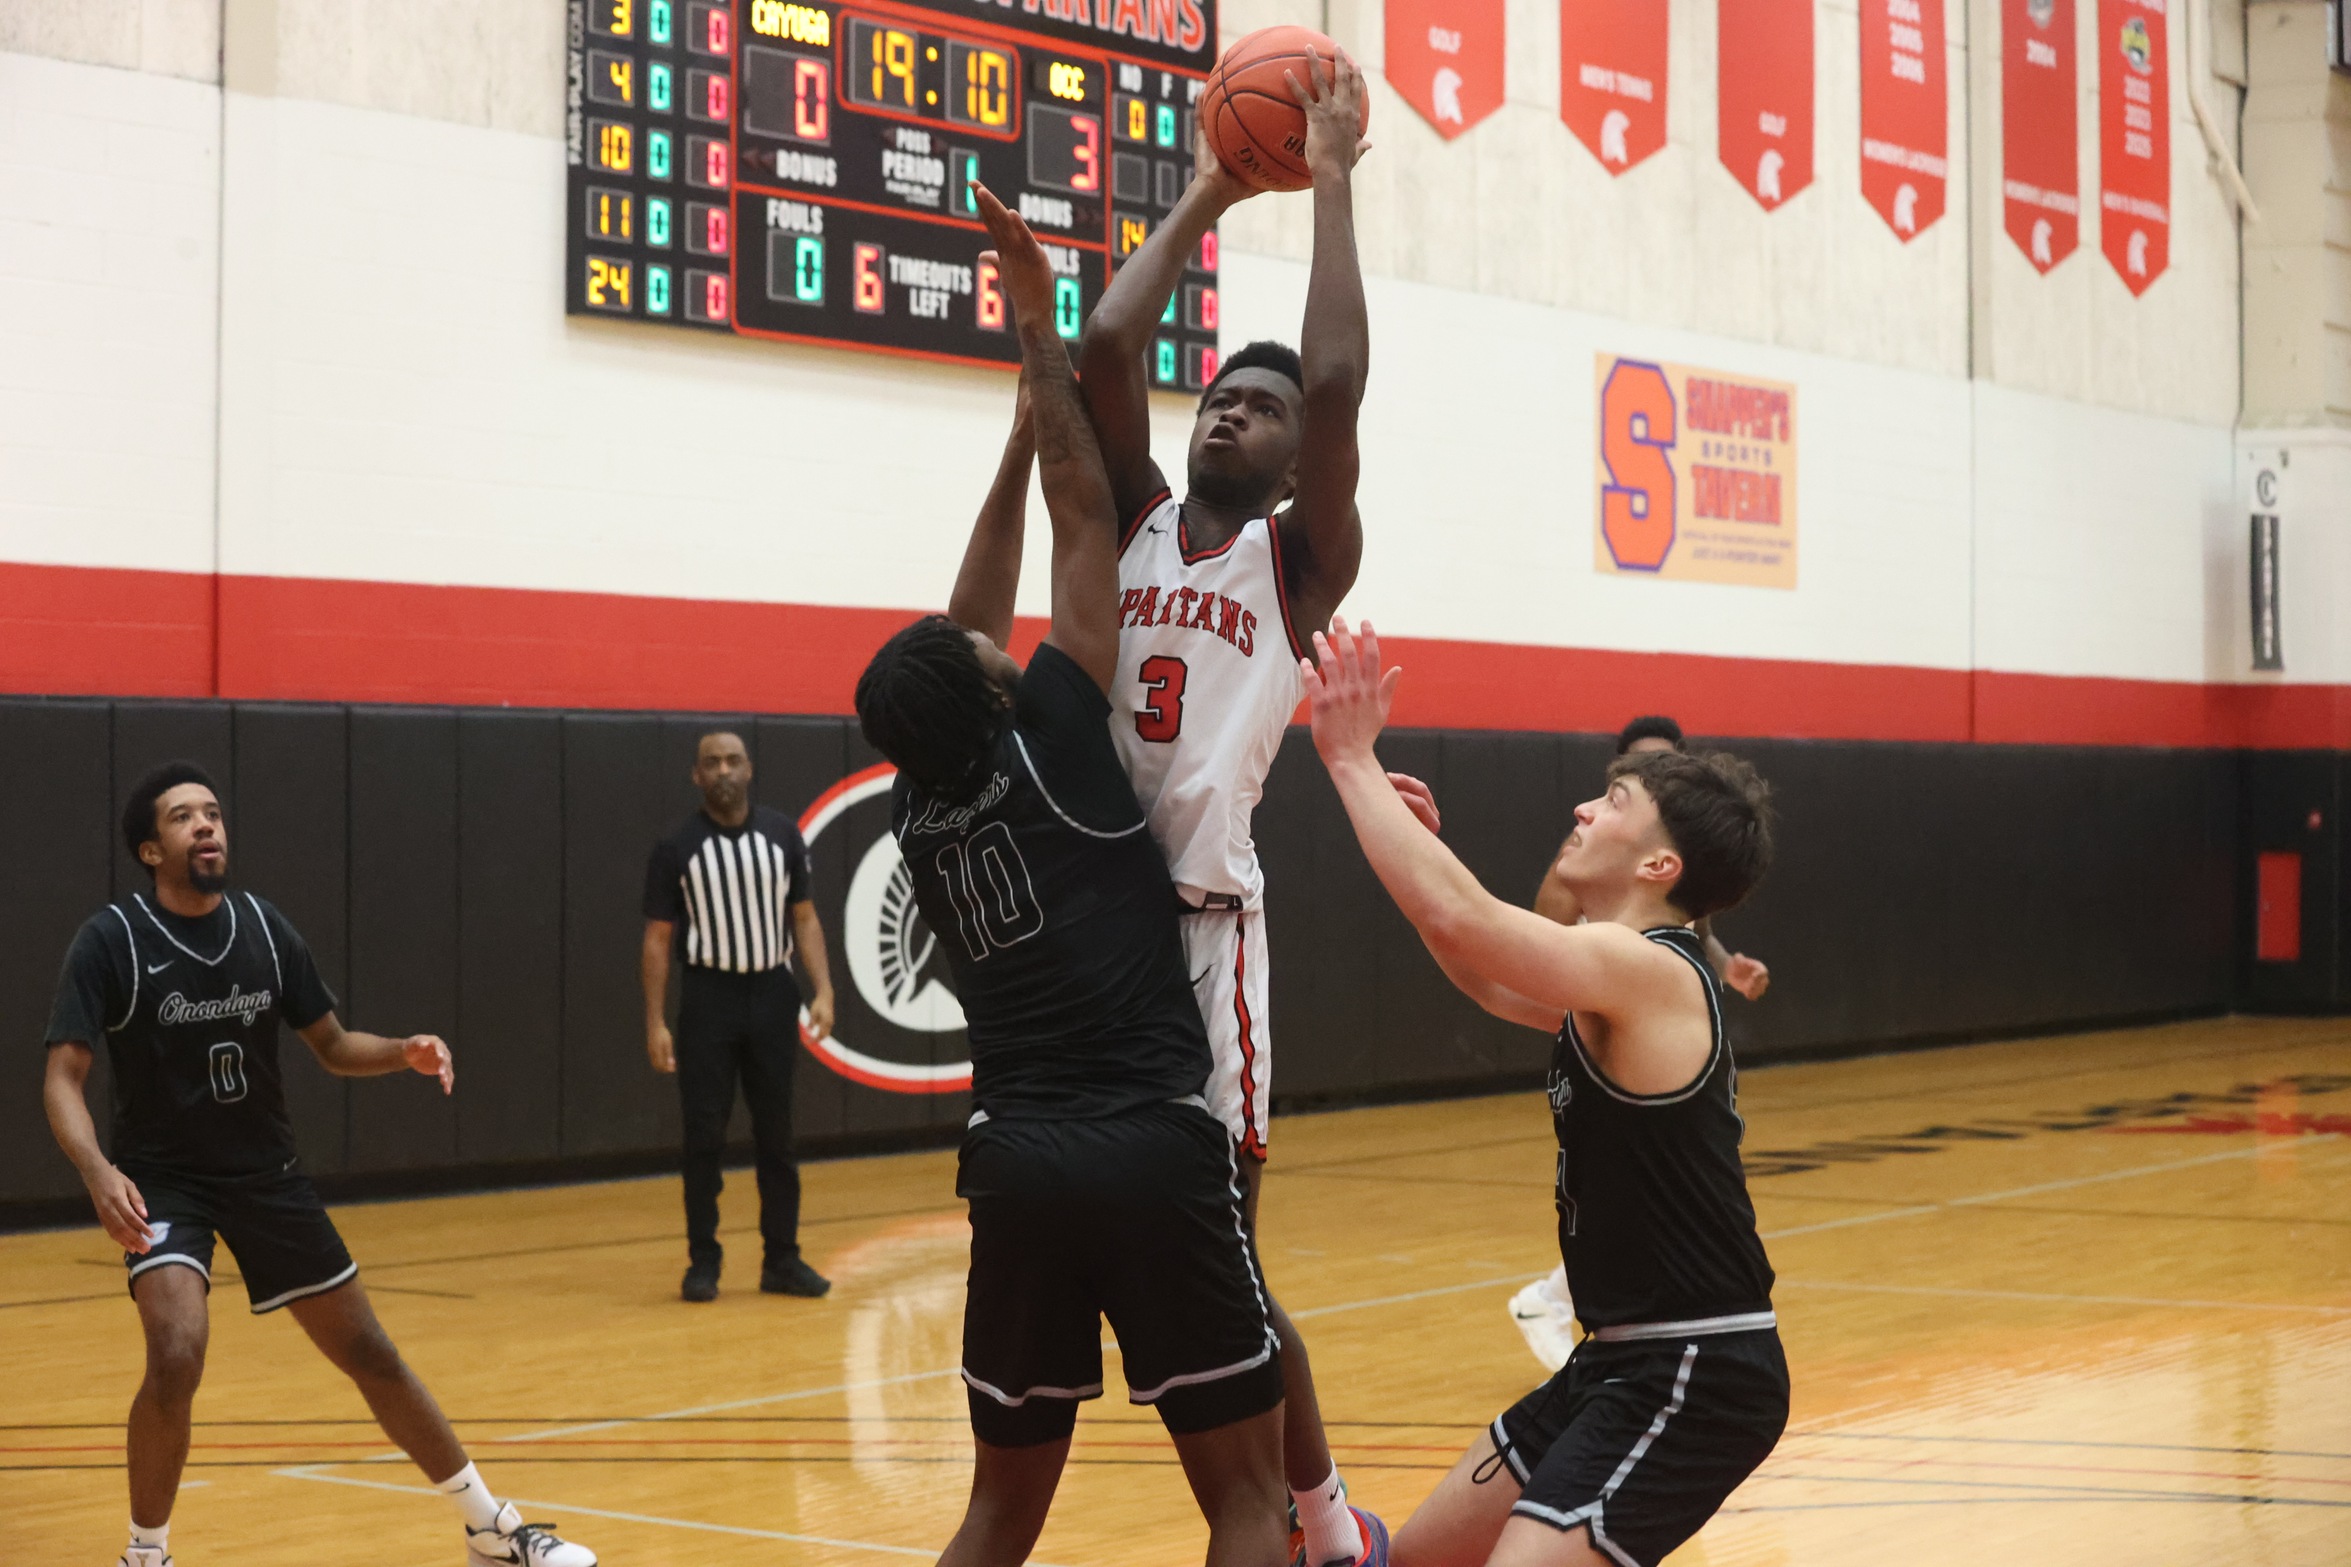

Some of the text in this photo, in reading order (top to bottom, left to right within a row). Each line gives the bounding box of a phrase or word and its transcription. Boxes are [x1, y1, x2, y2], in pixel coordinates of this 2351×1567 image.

[610, 0, 729, 55] 3 0 0
[752, 0, 829, 47] CAYUGA
[610, 61, 728, 120] 4 0 0
[795, 59, 828, 139] 0
[872, 29, 1007, 126] 19:10
[1049, 61, 1085, 102] OCC
[1070, 115, 1099, 190] 3
[1129, 99, 1175, 147] 0 0
[600, 125, 728, 187] 10 0 0
[776, 149, 838, 188] BONUS
[882, 149, 945, 187] PERIOD
[600, 194, 728, 253] 11 0 0
[766, 198, 824, 235] FOULS
[1019, 192, 1074, 228] BONUS
[588, 258, 727, 320] 24 0 0
[796, 237, 823, 300] 0
[856, 245, 883, 311] 6
[888, 253, 973, 295] TIMEOUTS
[1042, 243, 1081, 276] ULS
[909, 287, 950, 320] LEFT
[977, 263, 1004, 329] 6
[1056, 277, 1081, 338] 0
[1201, 288, 1219, 330] 0
[1158, 340, 1176, 382] 0
[1601, 357, 1677, 572] S
[1119, 586, 1257, 658] PATANS
[1134, 654, 1189, 744] 3
[935, 820, 1044, 962] 10
[157, 983, 272, 1026] Onondaga
[208, 1041, 248, 1103] 0
